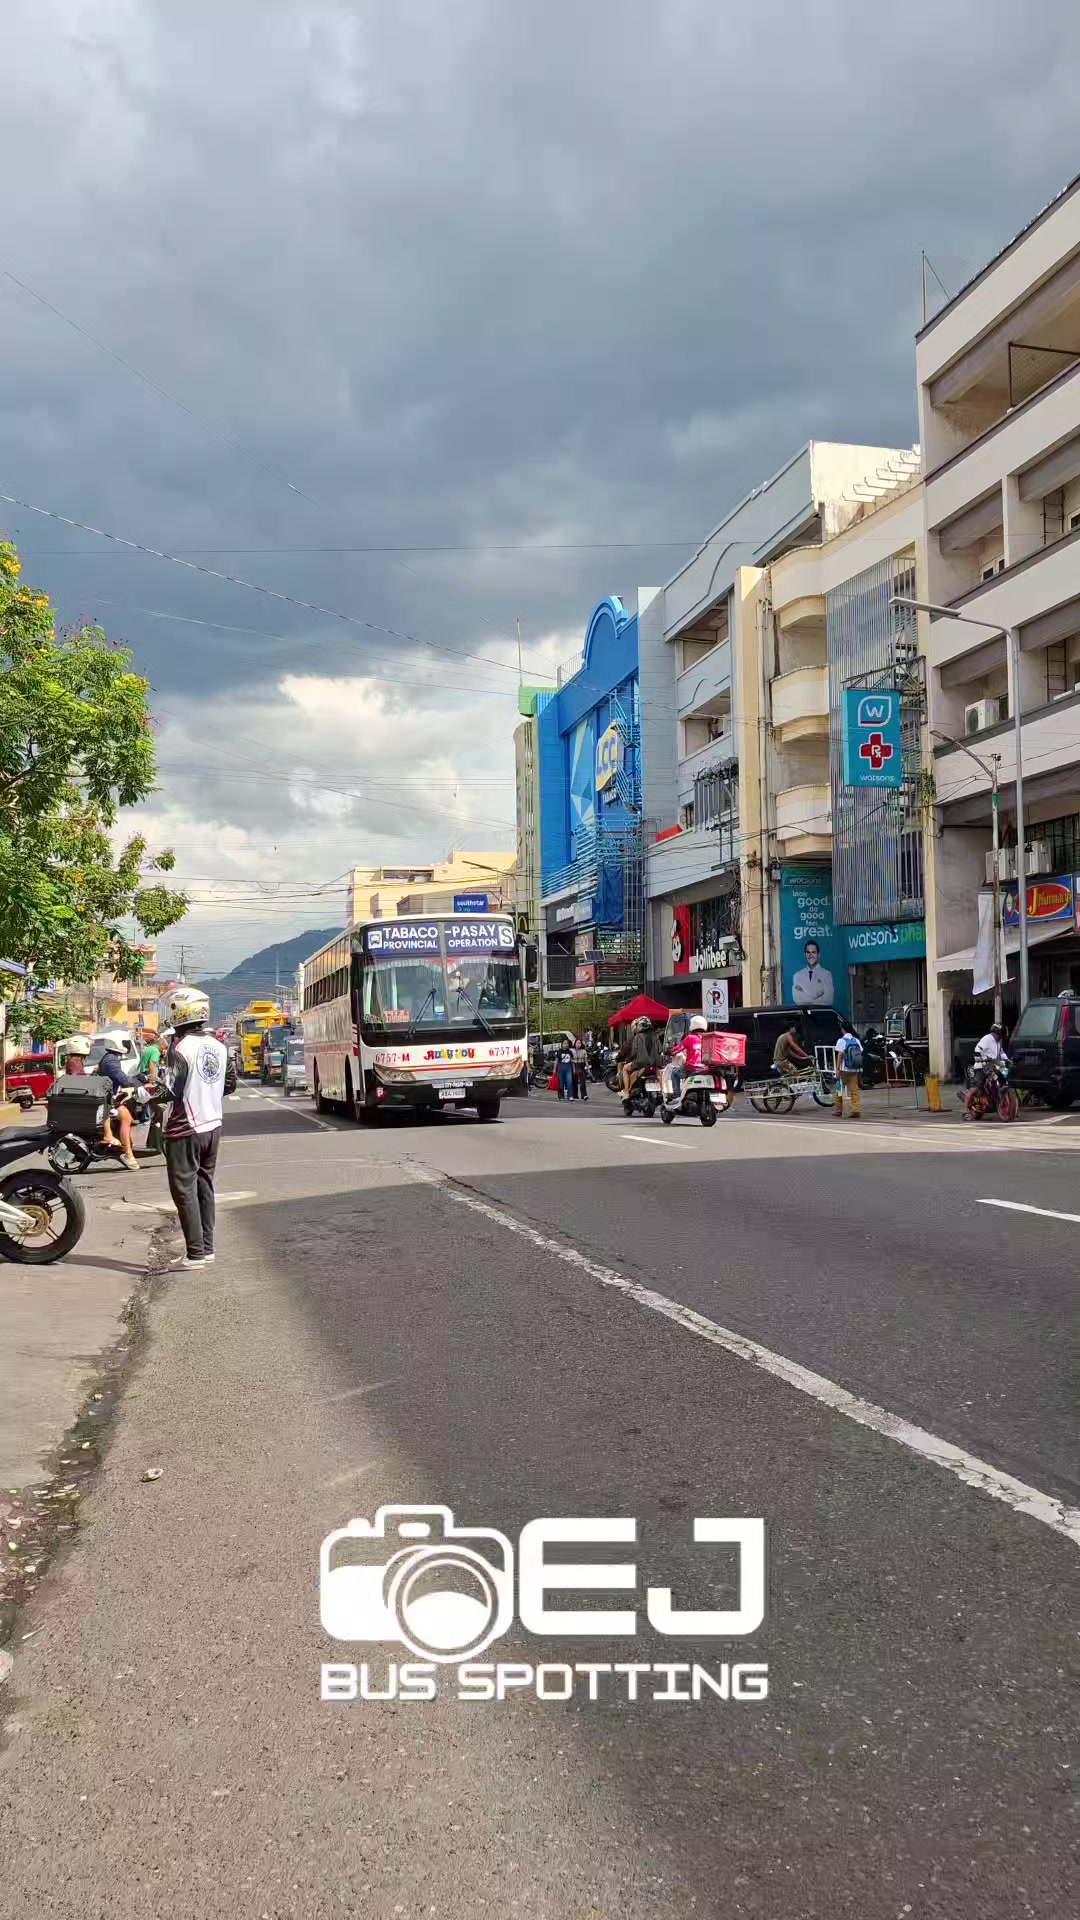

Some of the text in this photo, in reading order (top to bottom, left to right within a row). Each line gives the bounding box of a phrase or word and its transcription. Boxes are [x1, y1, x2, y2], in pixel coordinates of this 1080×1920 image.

[860, 774, 895, 783] watsons
[383, 927, 438, 939] TABACO
[793, 924, 833, 940] great.
[383, 938, 498, 949] PROVINCIAL OPERATION
[848, 928, 899, 949] watsons
